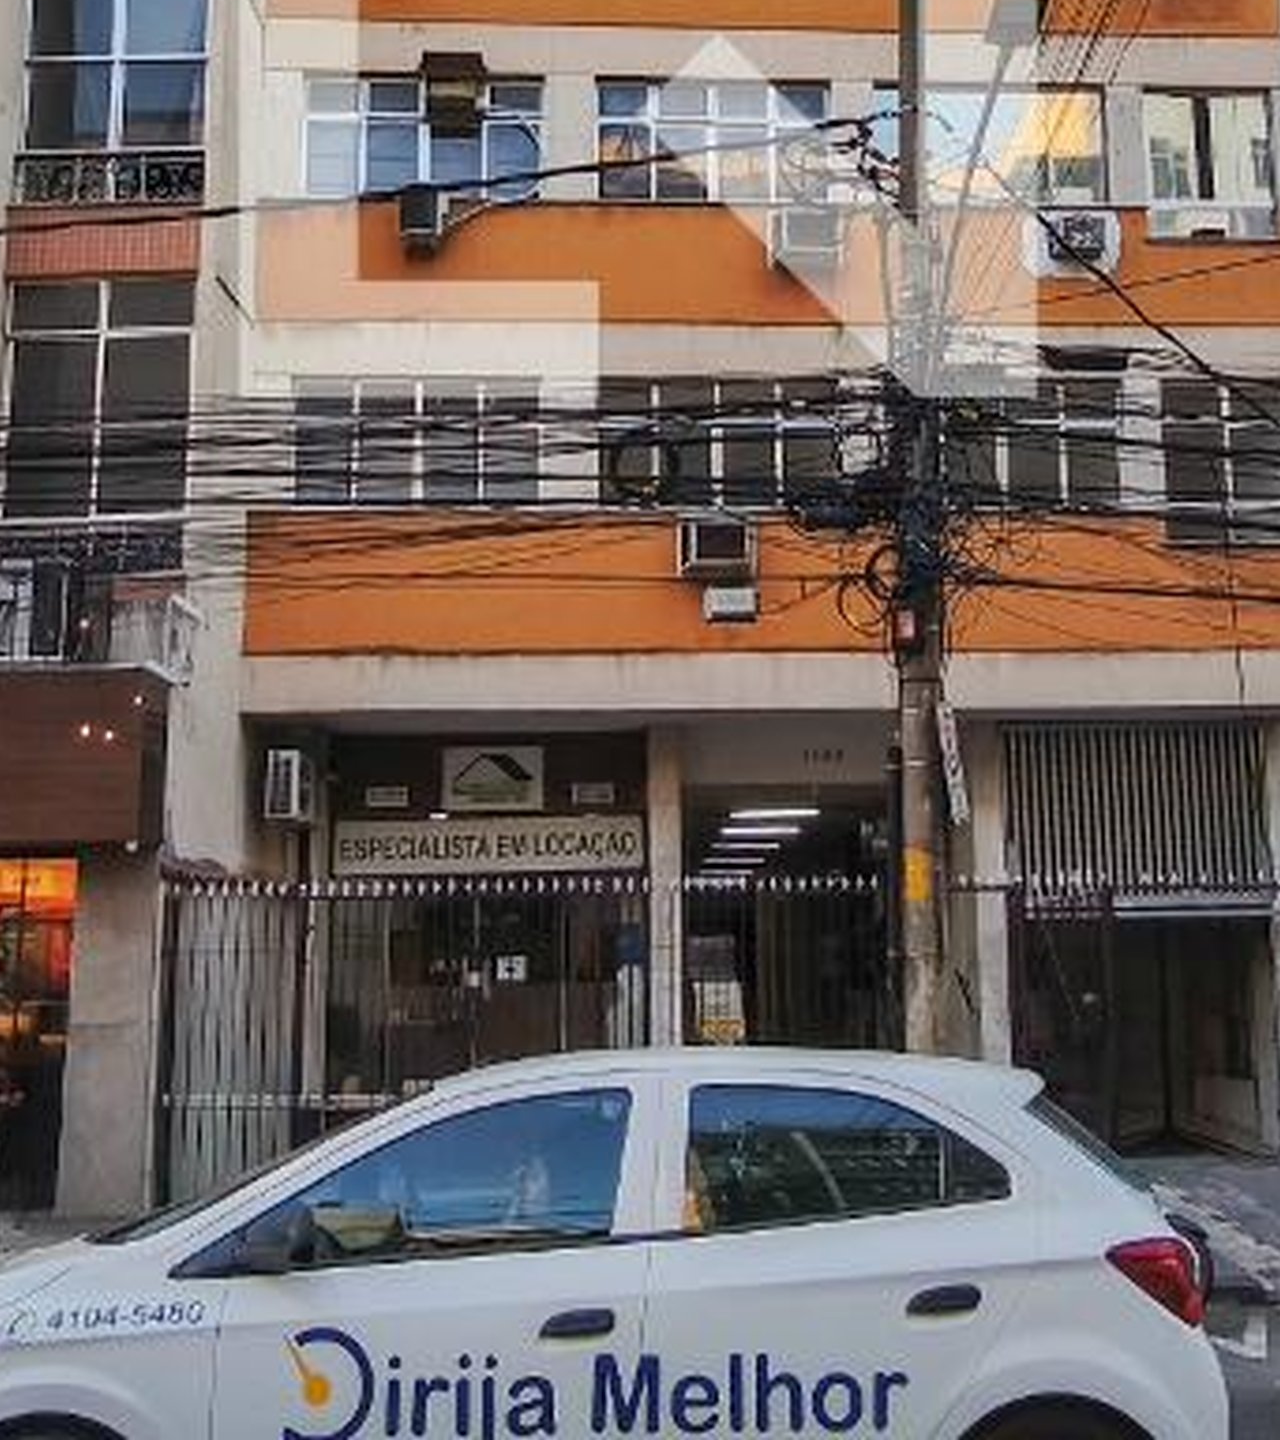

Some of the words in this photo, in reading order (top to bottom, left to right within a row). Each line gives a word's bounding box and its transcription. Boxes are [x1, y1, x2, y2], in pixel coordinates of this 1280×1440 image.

[339, 832, 491, 862] ESPECIALISTA
[496, 832, 527, 858] EM
[532, 828, 637, 861] LOCAÇÃO
[46, 1300, 206, 1330] 4104-5480
[282, 1326, 557, 1440] Dirija
[589, 1353, 911, 1436] Melhor
